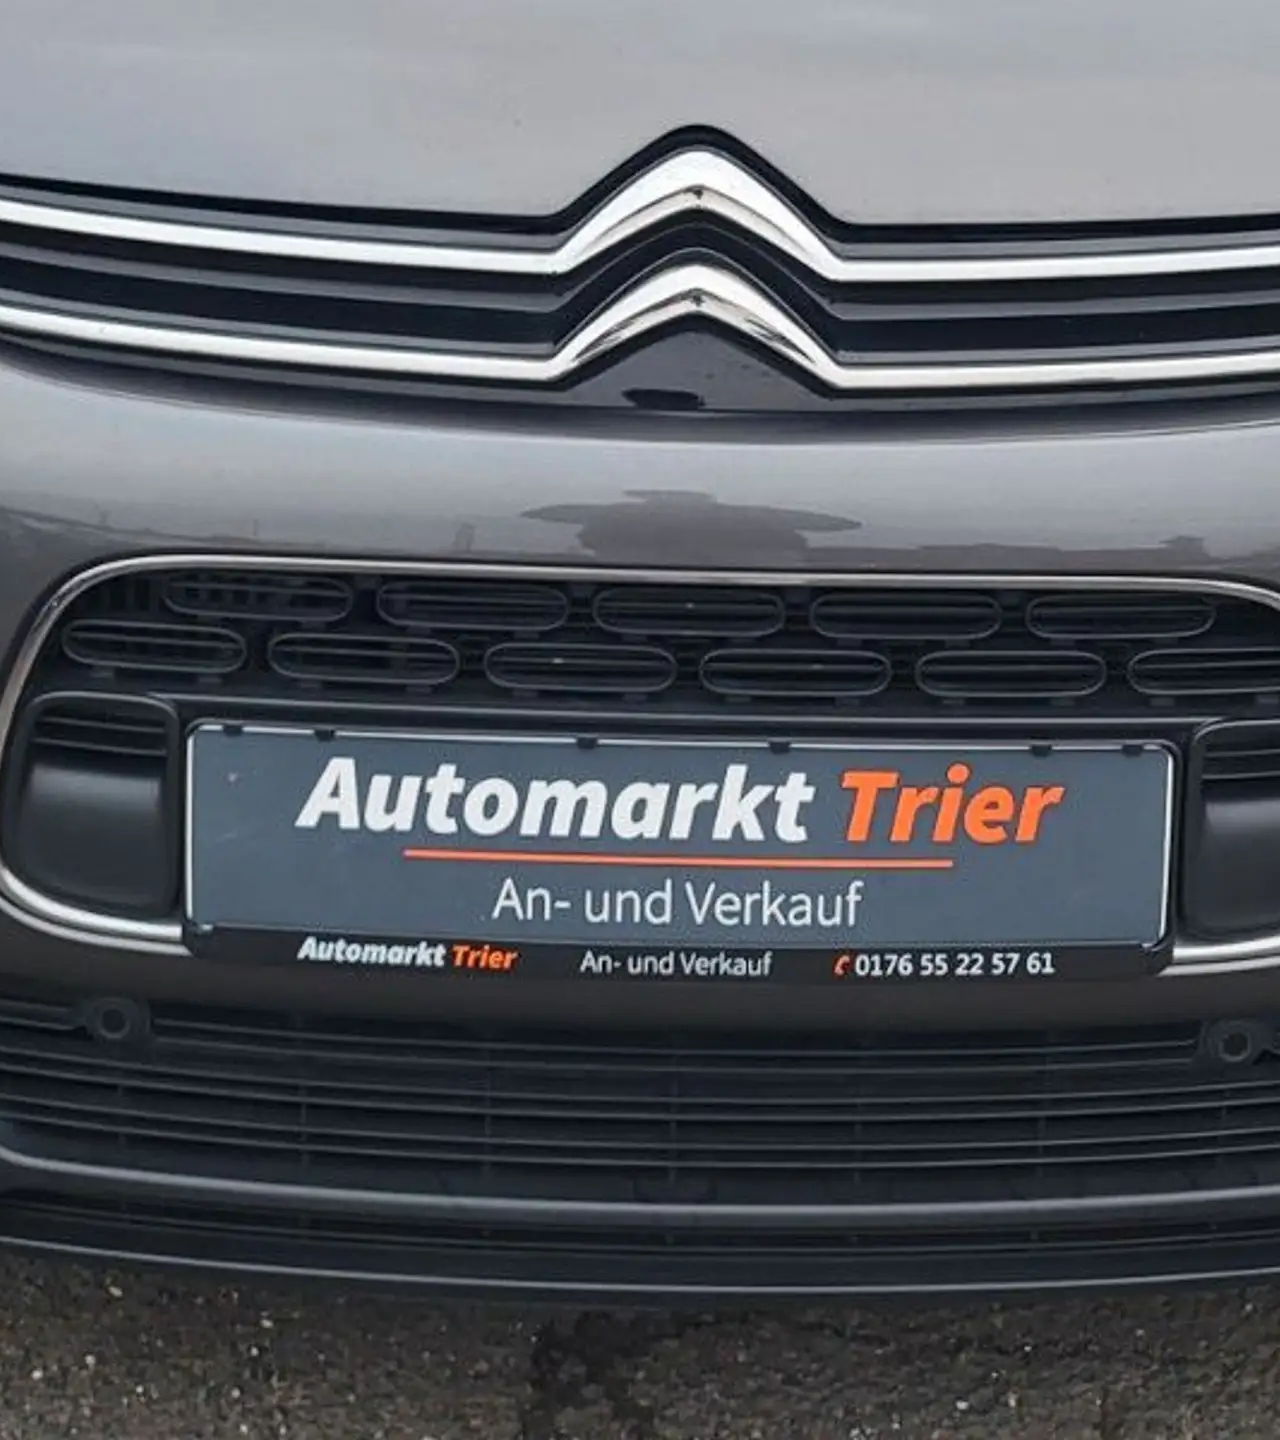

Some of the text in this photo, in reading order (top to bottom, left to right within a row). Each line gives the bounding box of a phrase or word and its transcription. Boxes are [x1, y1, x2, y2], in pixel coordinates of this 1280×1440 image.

[295, 756, 1065, 843] Automarkt Trier
[491, 877, 865, 927] An- und Verkauf
[297, 935, 1055, 977] Automarkt Trier An- und Verkauf 0176 55 22 57 61
